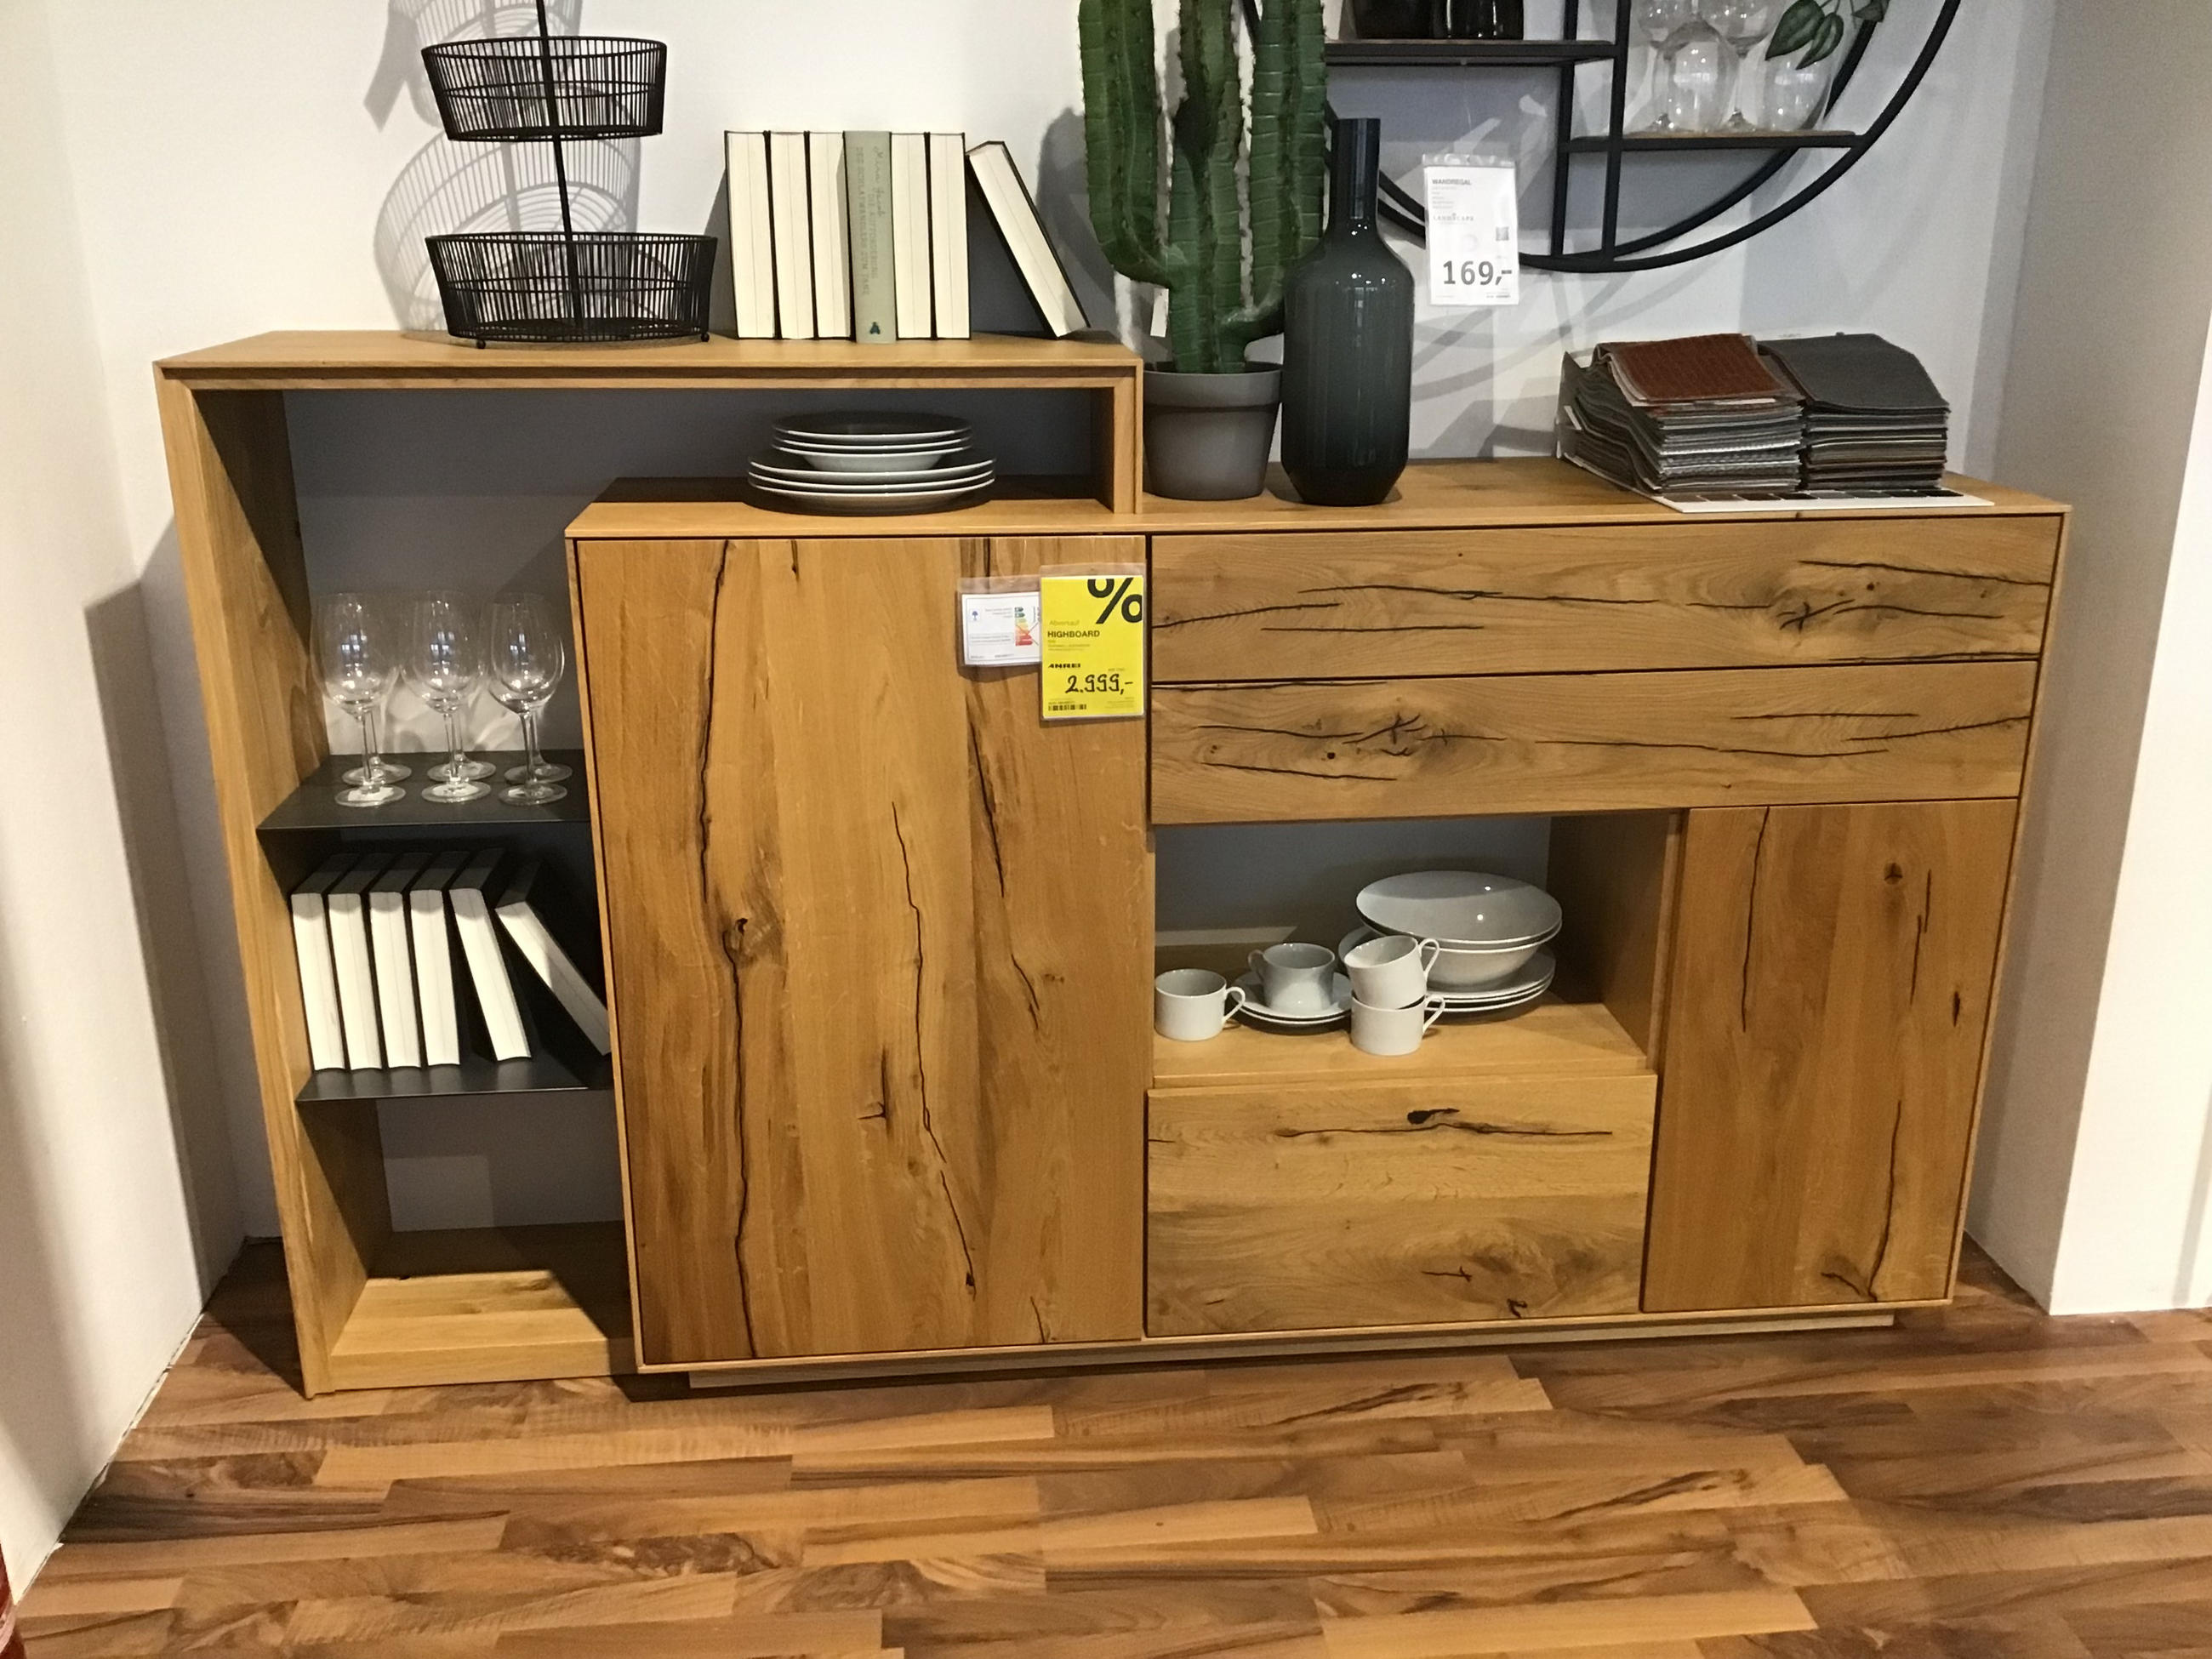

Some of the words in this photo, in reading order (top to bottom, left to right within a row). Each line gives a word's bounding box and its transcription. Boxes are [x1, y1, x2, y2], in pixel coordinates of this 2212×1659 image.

[1443, 260, 1513, 286] 169,-
[1047, 630, 1100, 638] HIGHBOARD
[1065, 673, 1133, 695] 2.999,-
